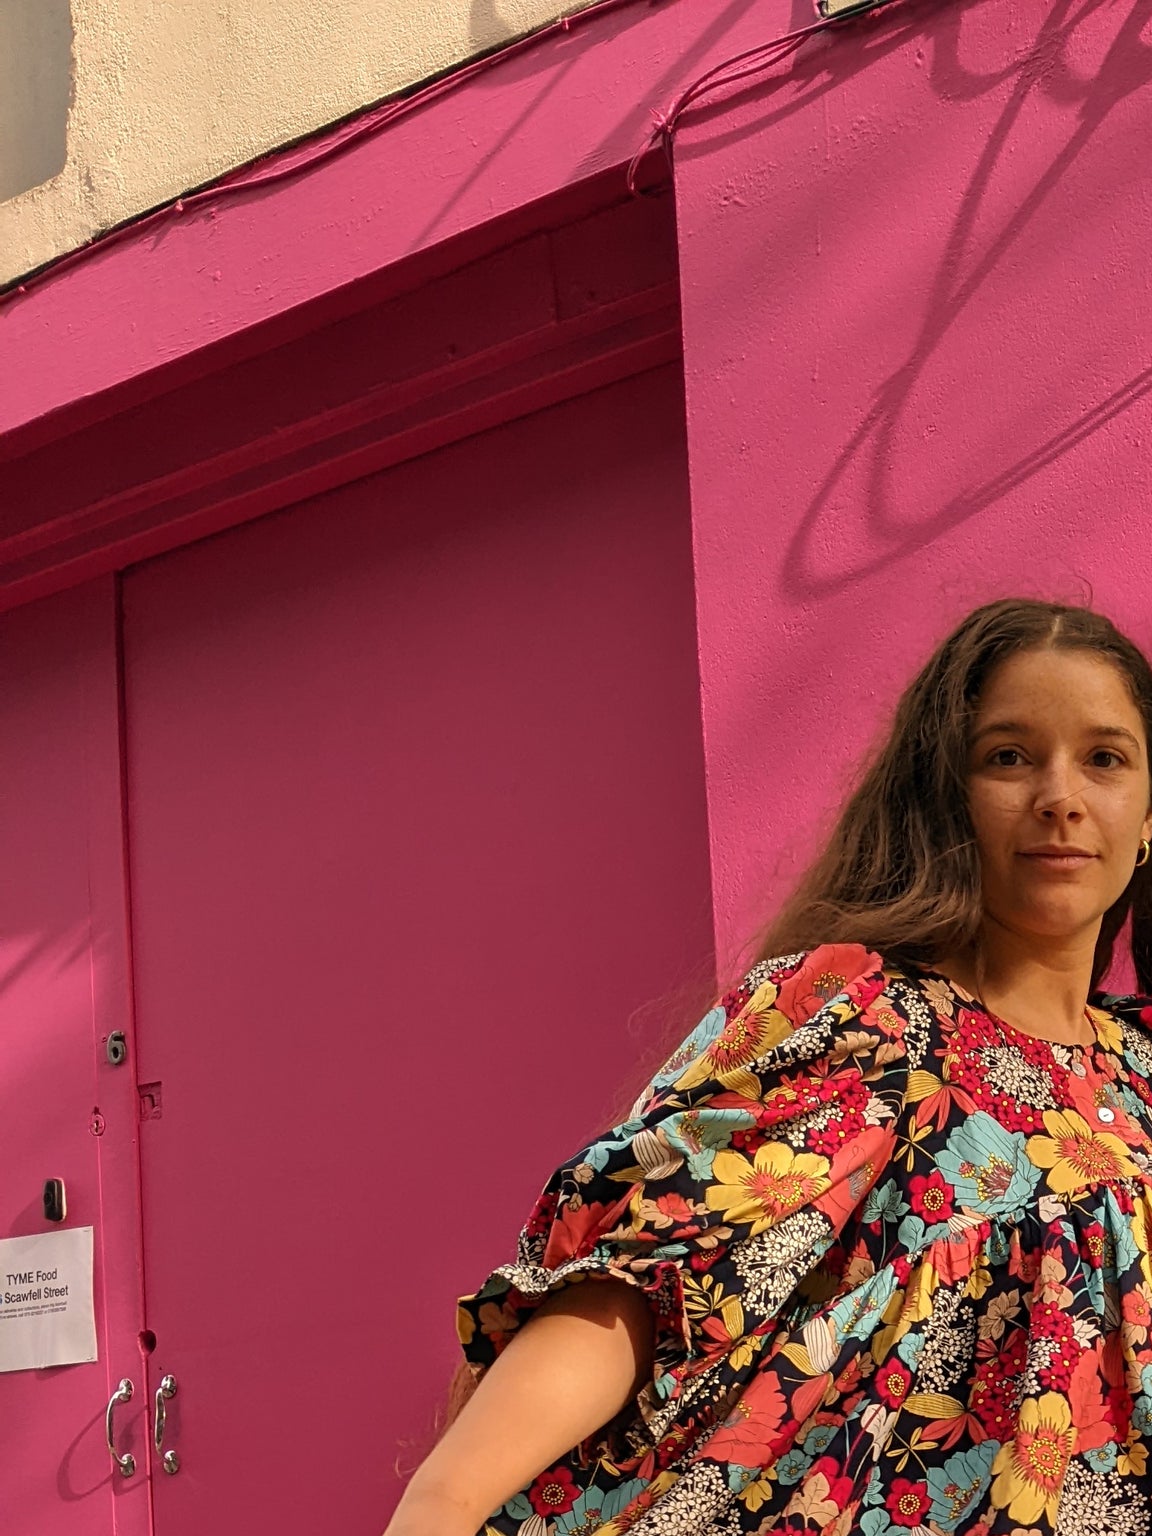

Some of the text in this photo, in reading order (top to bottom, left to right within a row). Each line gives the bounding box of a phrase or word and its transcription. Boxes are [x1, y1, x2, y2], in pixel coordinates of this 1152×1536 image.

[107, 1031, 125, 1064] 6
[6, 1268, 57, 1286] TYME Food
[4, 1288, 42, 1304] Scawfell
[43, 1285, 69, 1299] Street
